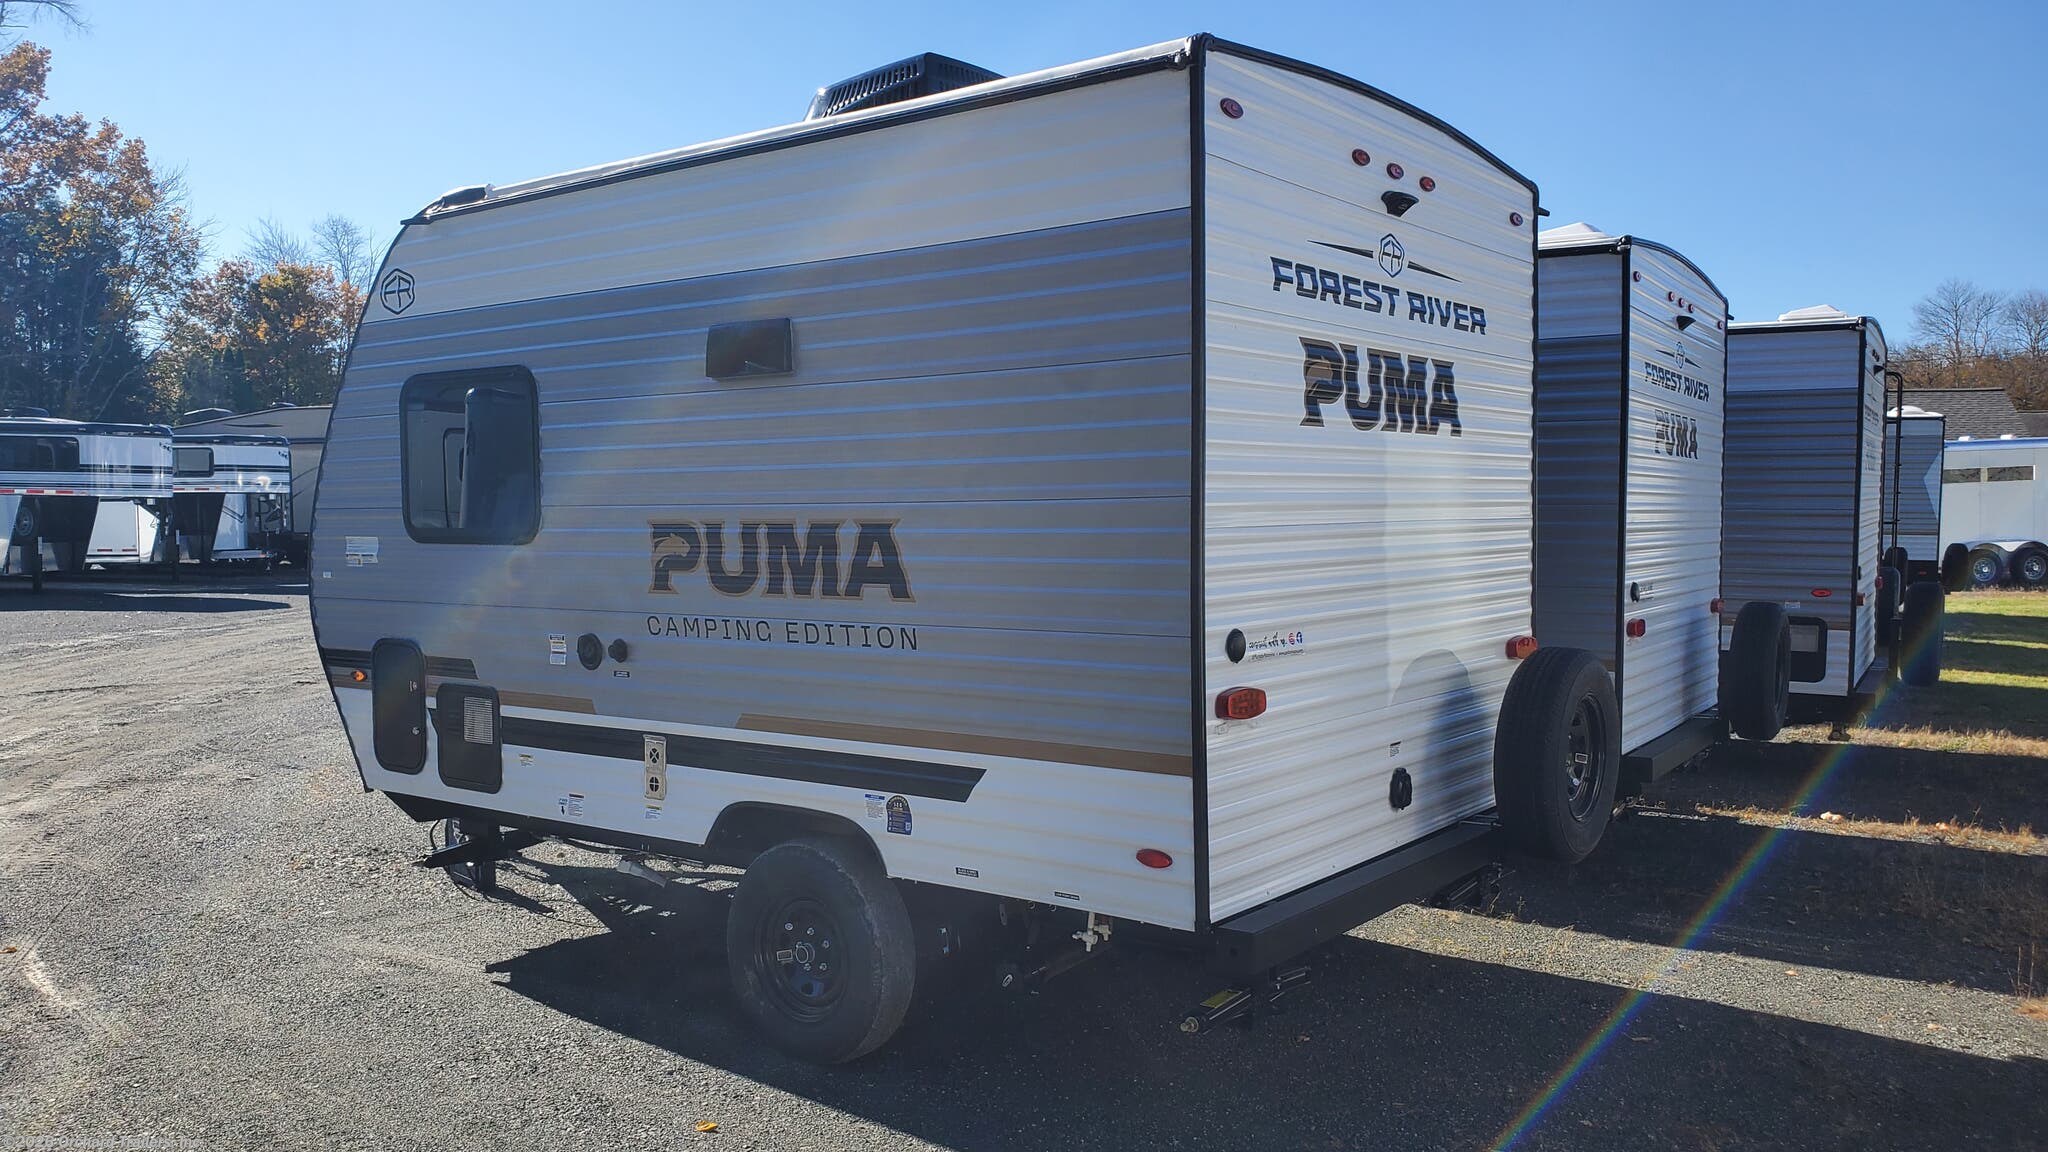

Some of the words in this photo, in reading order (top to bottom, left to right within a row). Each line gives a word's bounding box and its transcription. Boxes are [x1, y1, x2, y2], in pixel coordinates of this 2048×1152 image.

[1270, 256, 1400, 316] FOREST
[1406, 291, 1488, 335] RIVER
[1299, 336, 1463, 437] PUMA
[1644, 361, 1682, 393] FOREST
[1683, 376, 1710, 402] RIVER
[1654, 409, 1698, 460] PUMA
[647, 518, 916, 602] PUMA
[646, 615, 772, 642] CAMPING
[785, 622, 918, 650] EDITION
